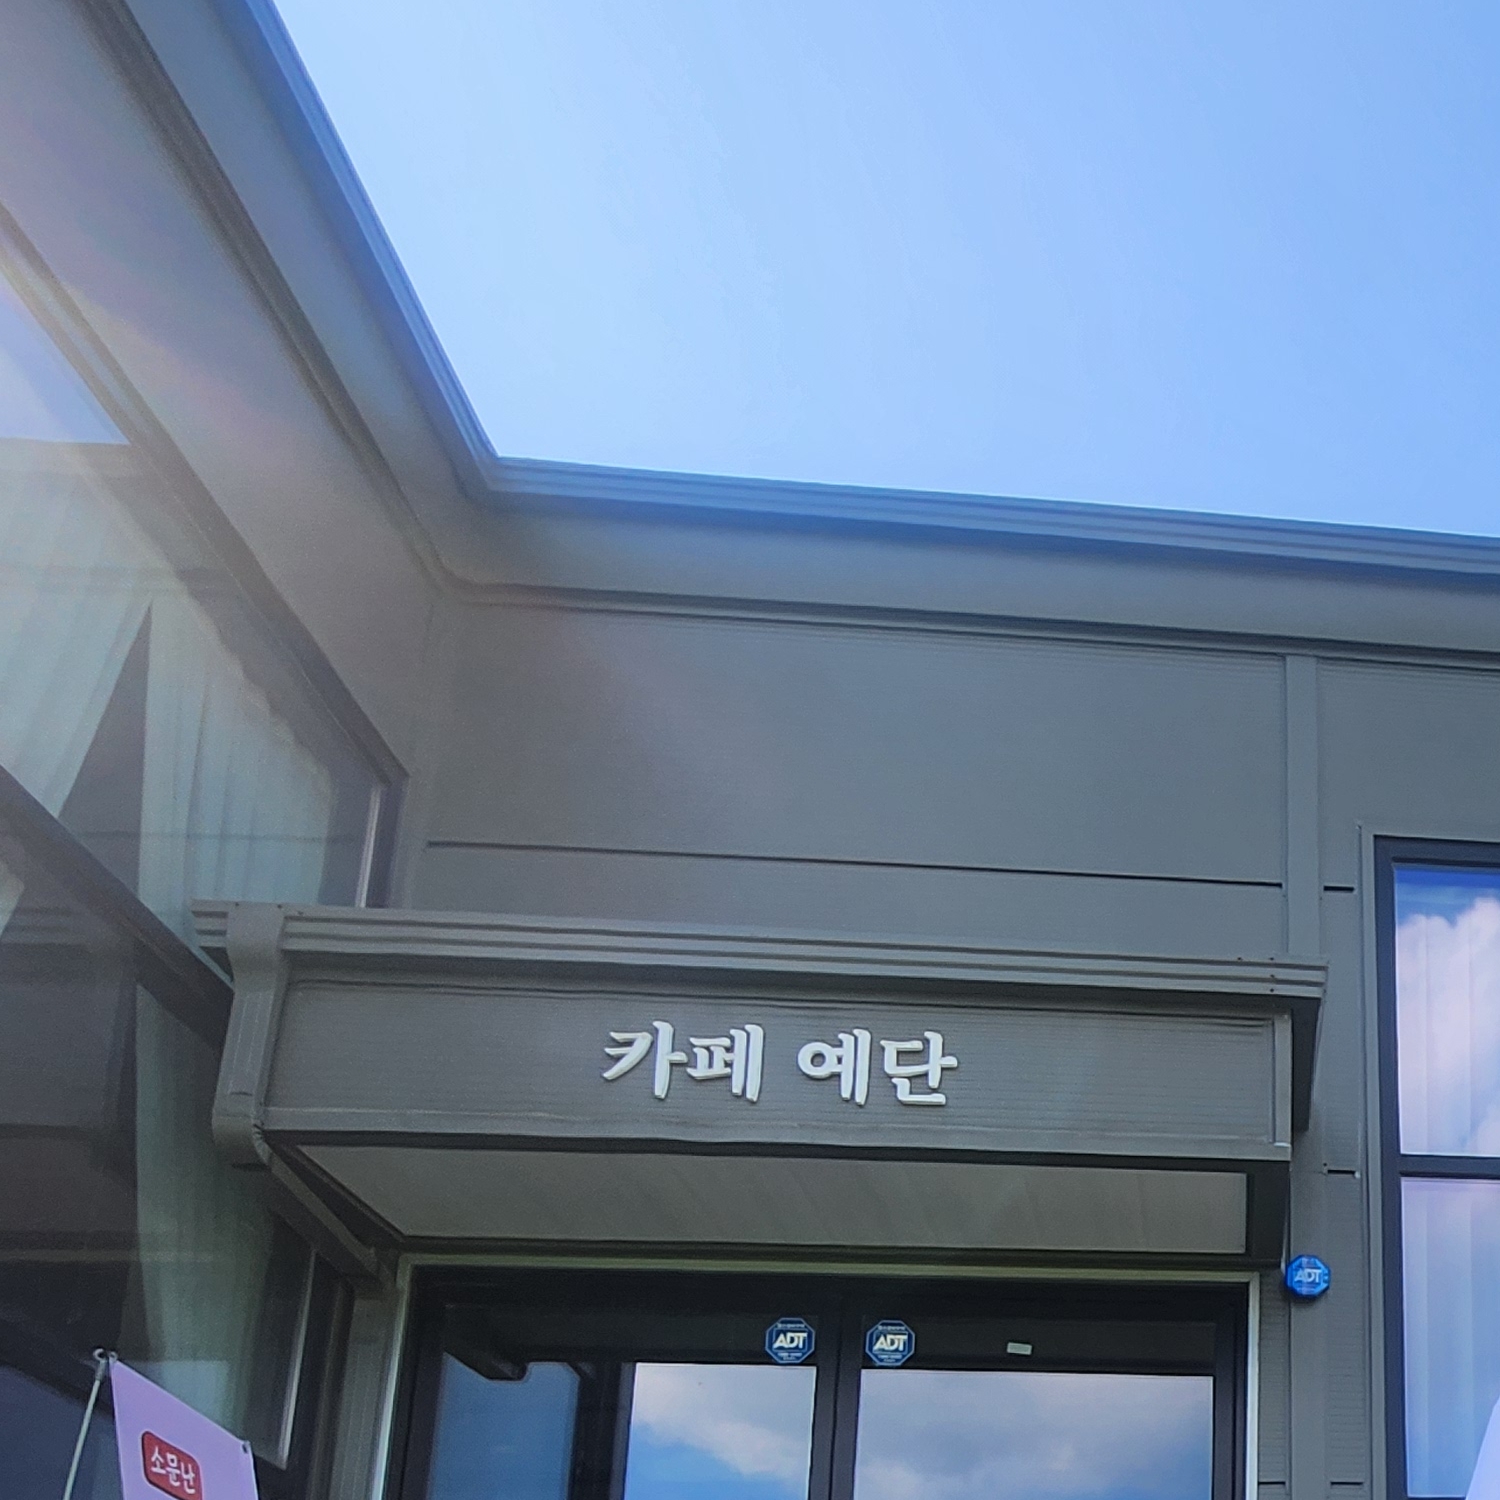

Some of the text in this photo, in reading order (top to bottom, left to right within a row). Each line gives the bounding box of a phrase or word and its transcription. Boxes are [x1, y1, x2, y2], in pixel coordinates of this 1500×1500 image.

[602, 1020, 958, 1106] 카페 예단
[1294, 1268, 1322, 1283] ADT
[773, 1332, 808, 1349] ADT
[872, 1334, 908, 1351] ADT
[151, 1446, 196, 1494] 소문난
